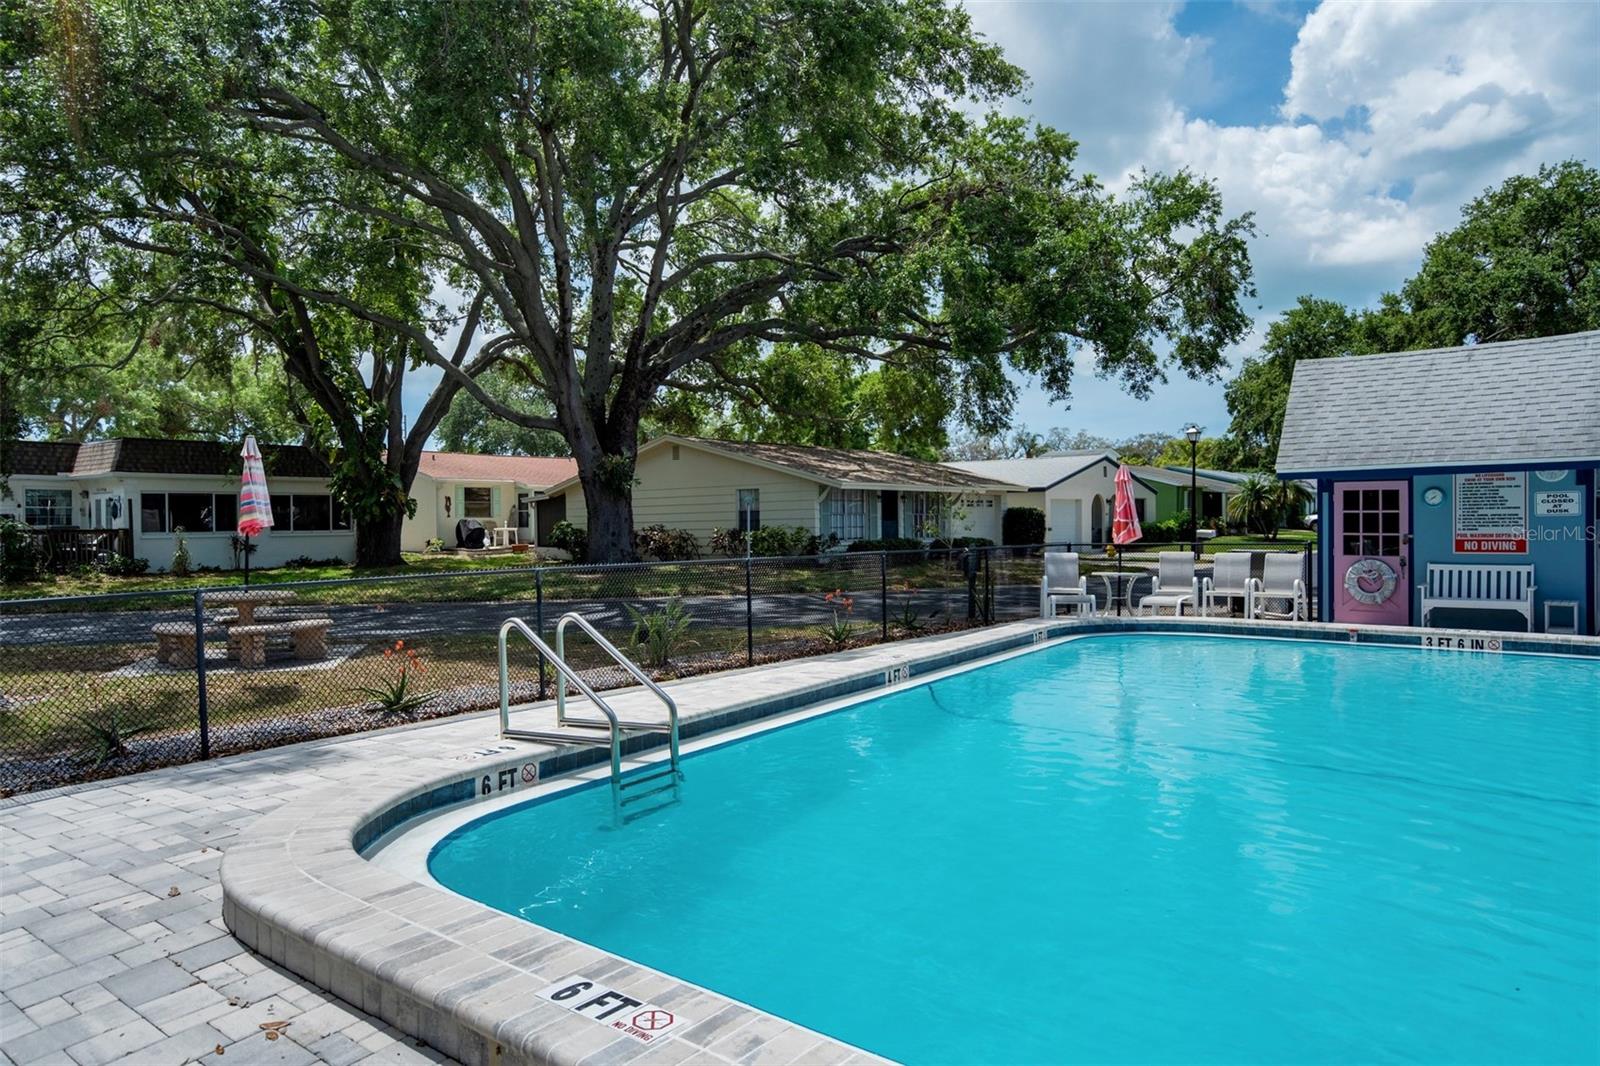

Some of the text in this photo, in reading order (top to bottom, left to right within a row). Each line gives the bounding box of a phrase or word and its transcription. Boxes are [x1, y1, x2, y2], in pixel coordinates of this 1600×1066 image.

[1464, 541, 1516, 551] NO DIVING
[1426, 637, 1484, 650] 3 FT 6 IN
[894, 668, 900, 681] FT
[482, 767, 518, 795] 6 FT
[550, 981, 643, 1021] 6 FT
[612, 1021, 653, 1041] NO DIVING
